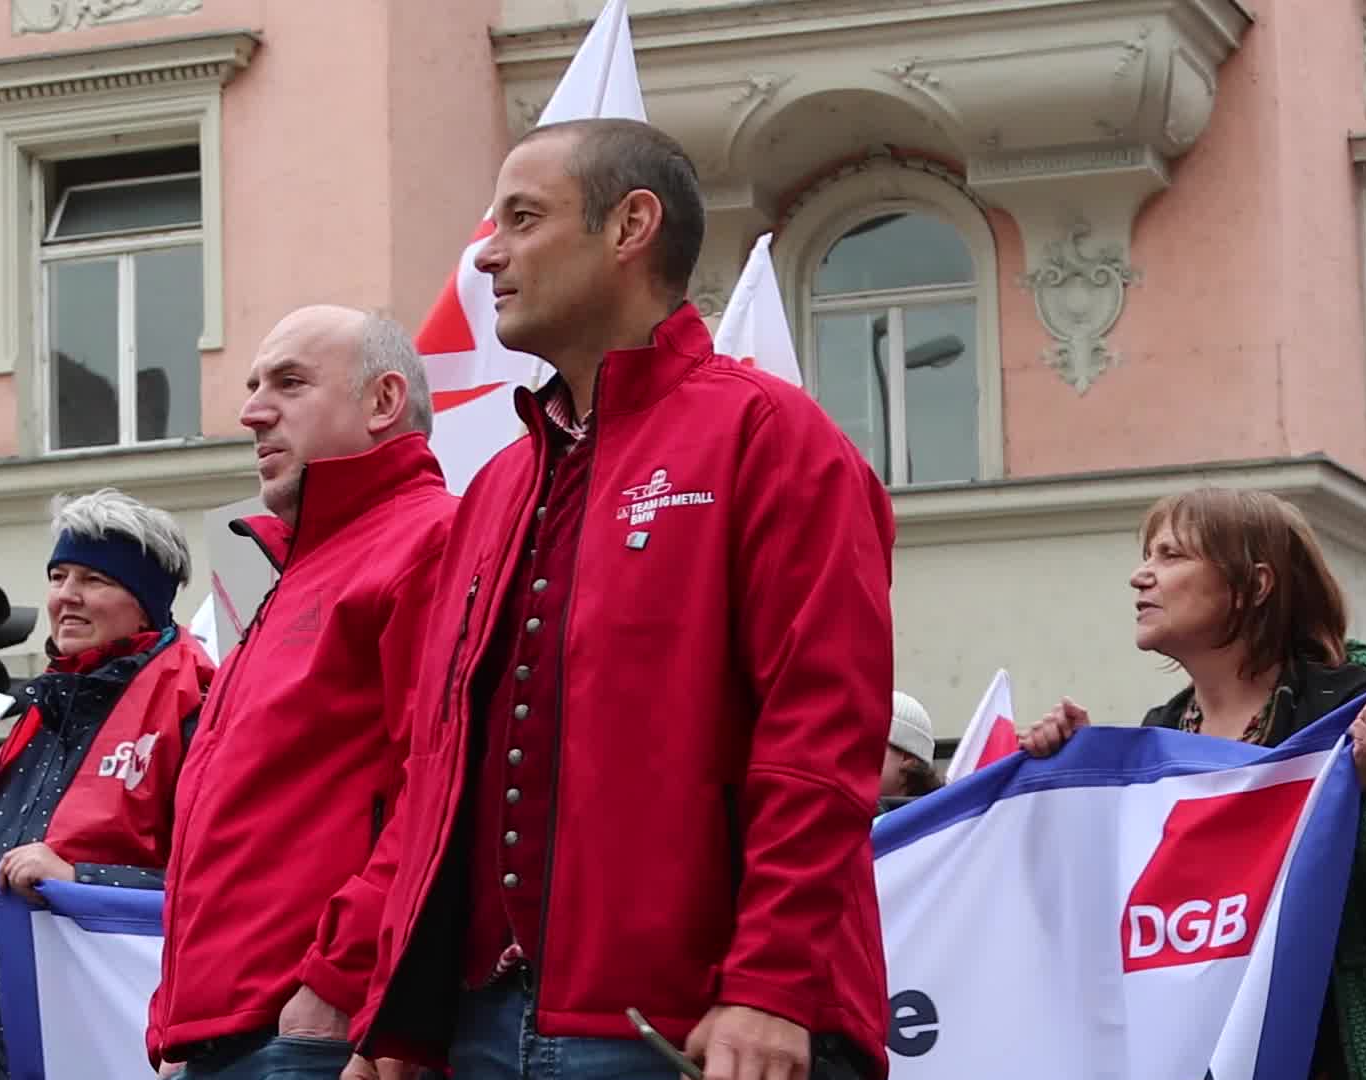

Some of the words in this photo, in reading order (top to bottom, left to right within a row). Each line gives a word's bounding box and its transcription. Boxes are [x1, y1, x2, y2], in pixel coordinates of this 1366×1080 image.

[631, 498, 658, 514] TEAM
[658, 495, 670, 508] IG
[671, 491, 715, 506] METALL
[630, 509, 656, 526] BMW
[1126, 893, 1248, 960] DGB
